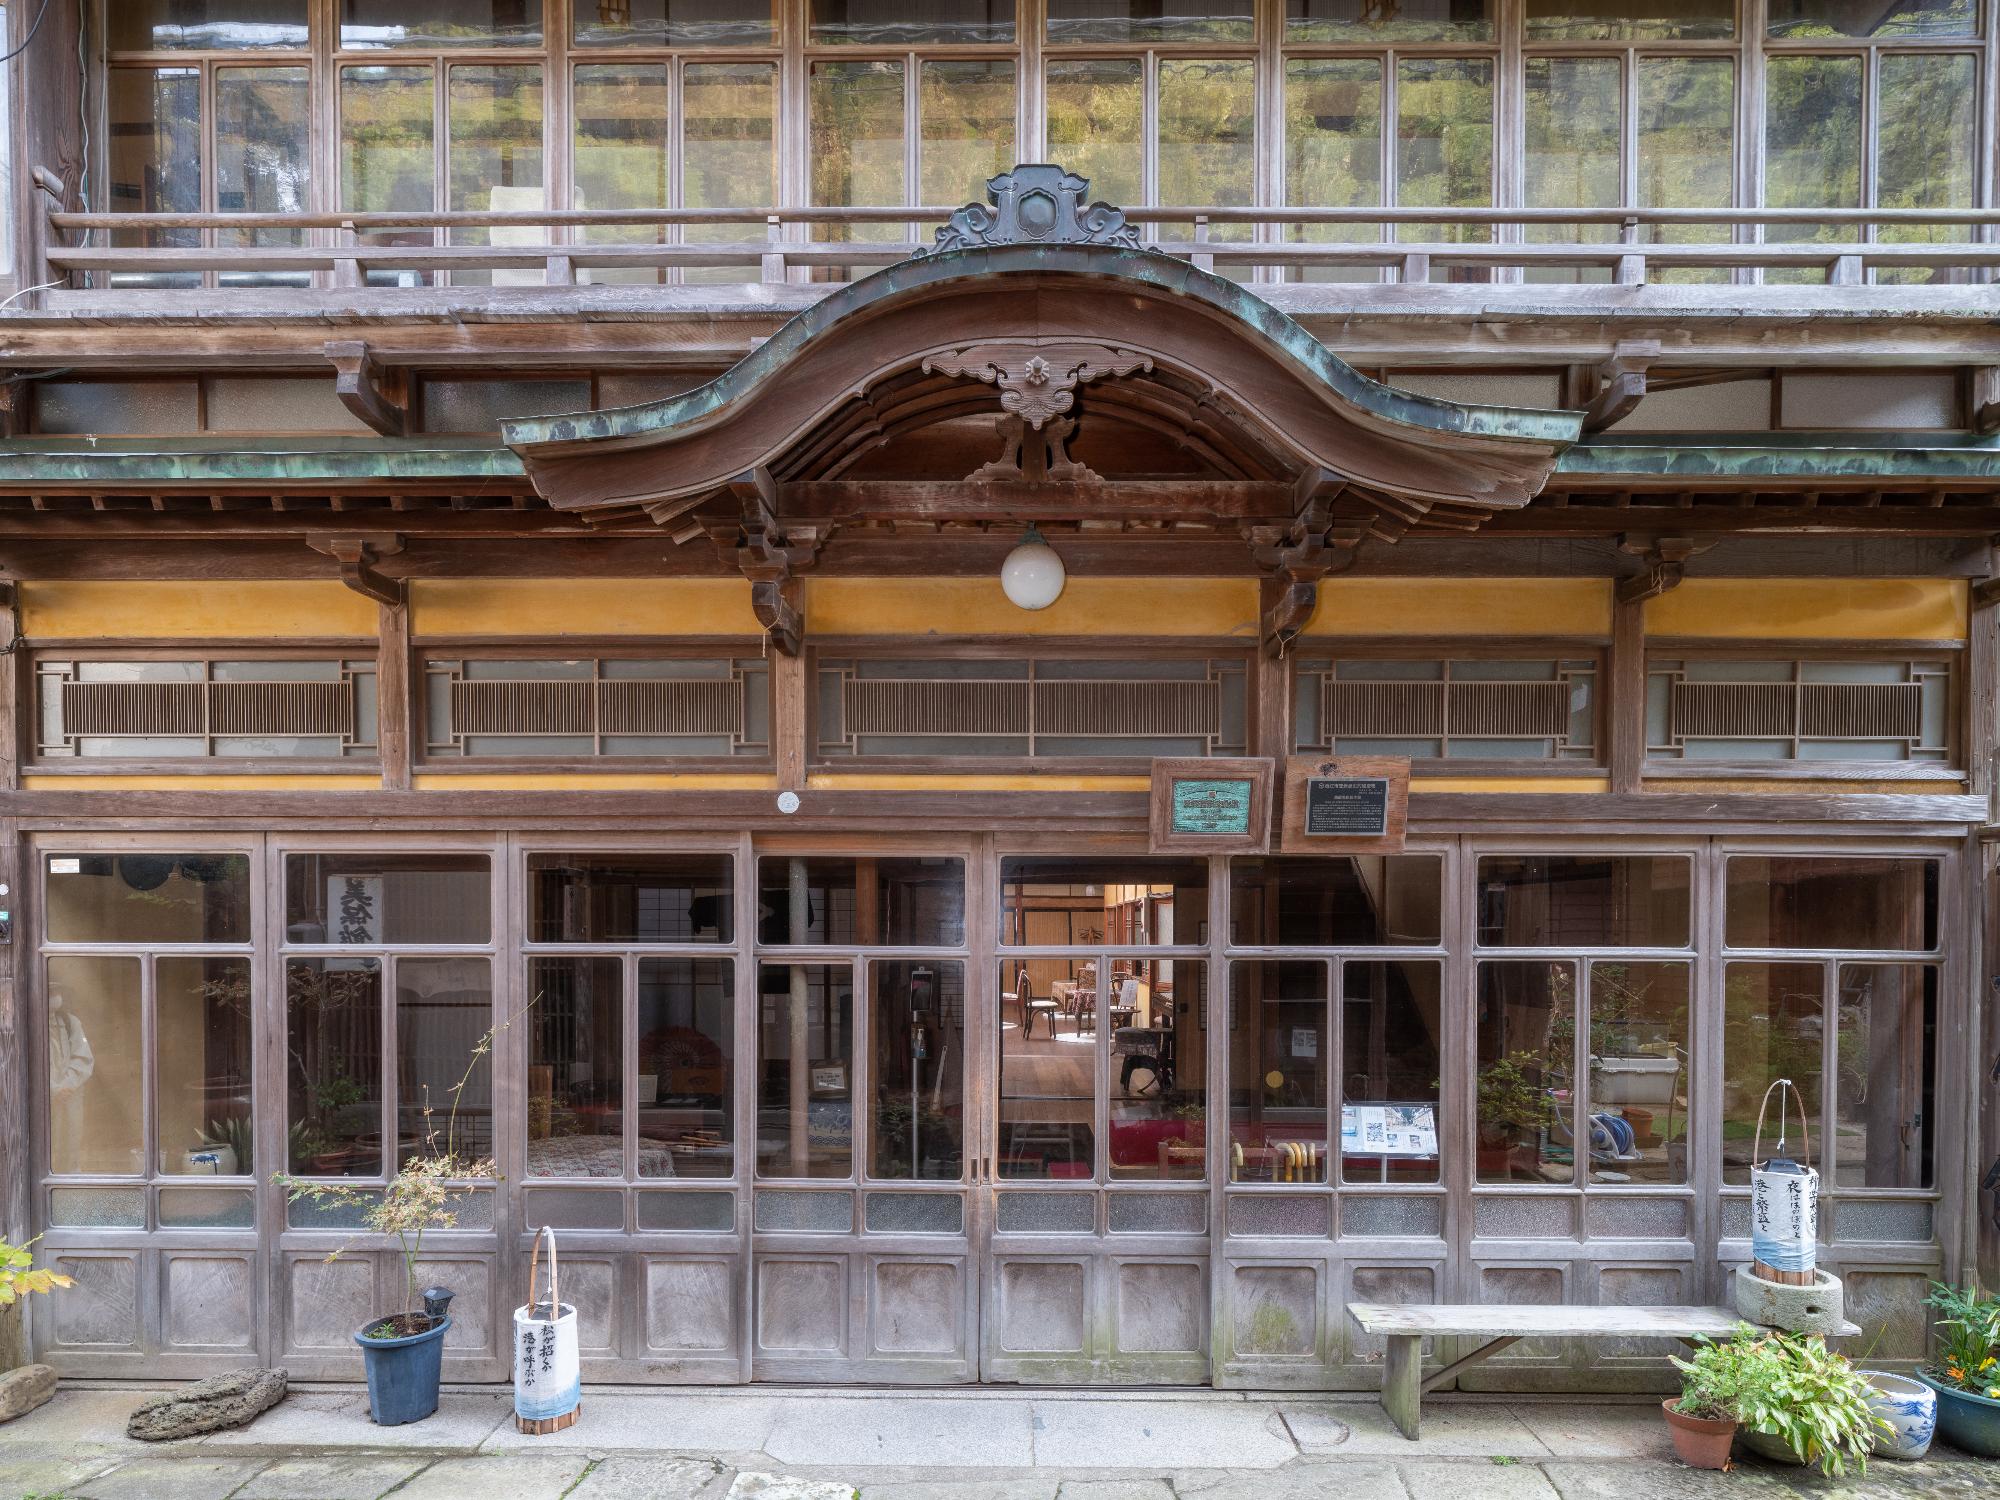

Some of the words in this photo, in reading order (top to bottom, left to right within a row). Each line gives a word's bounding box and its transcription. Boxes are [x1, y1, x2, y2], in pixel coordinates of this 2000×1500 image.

[523, 1331, 536, 1386] 港が呼ぶか
[539, 1325, 555, 1372] 松が招くか
